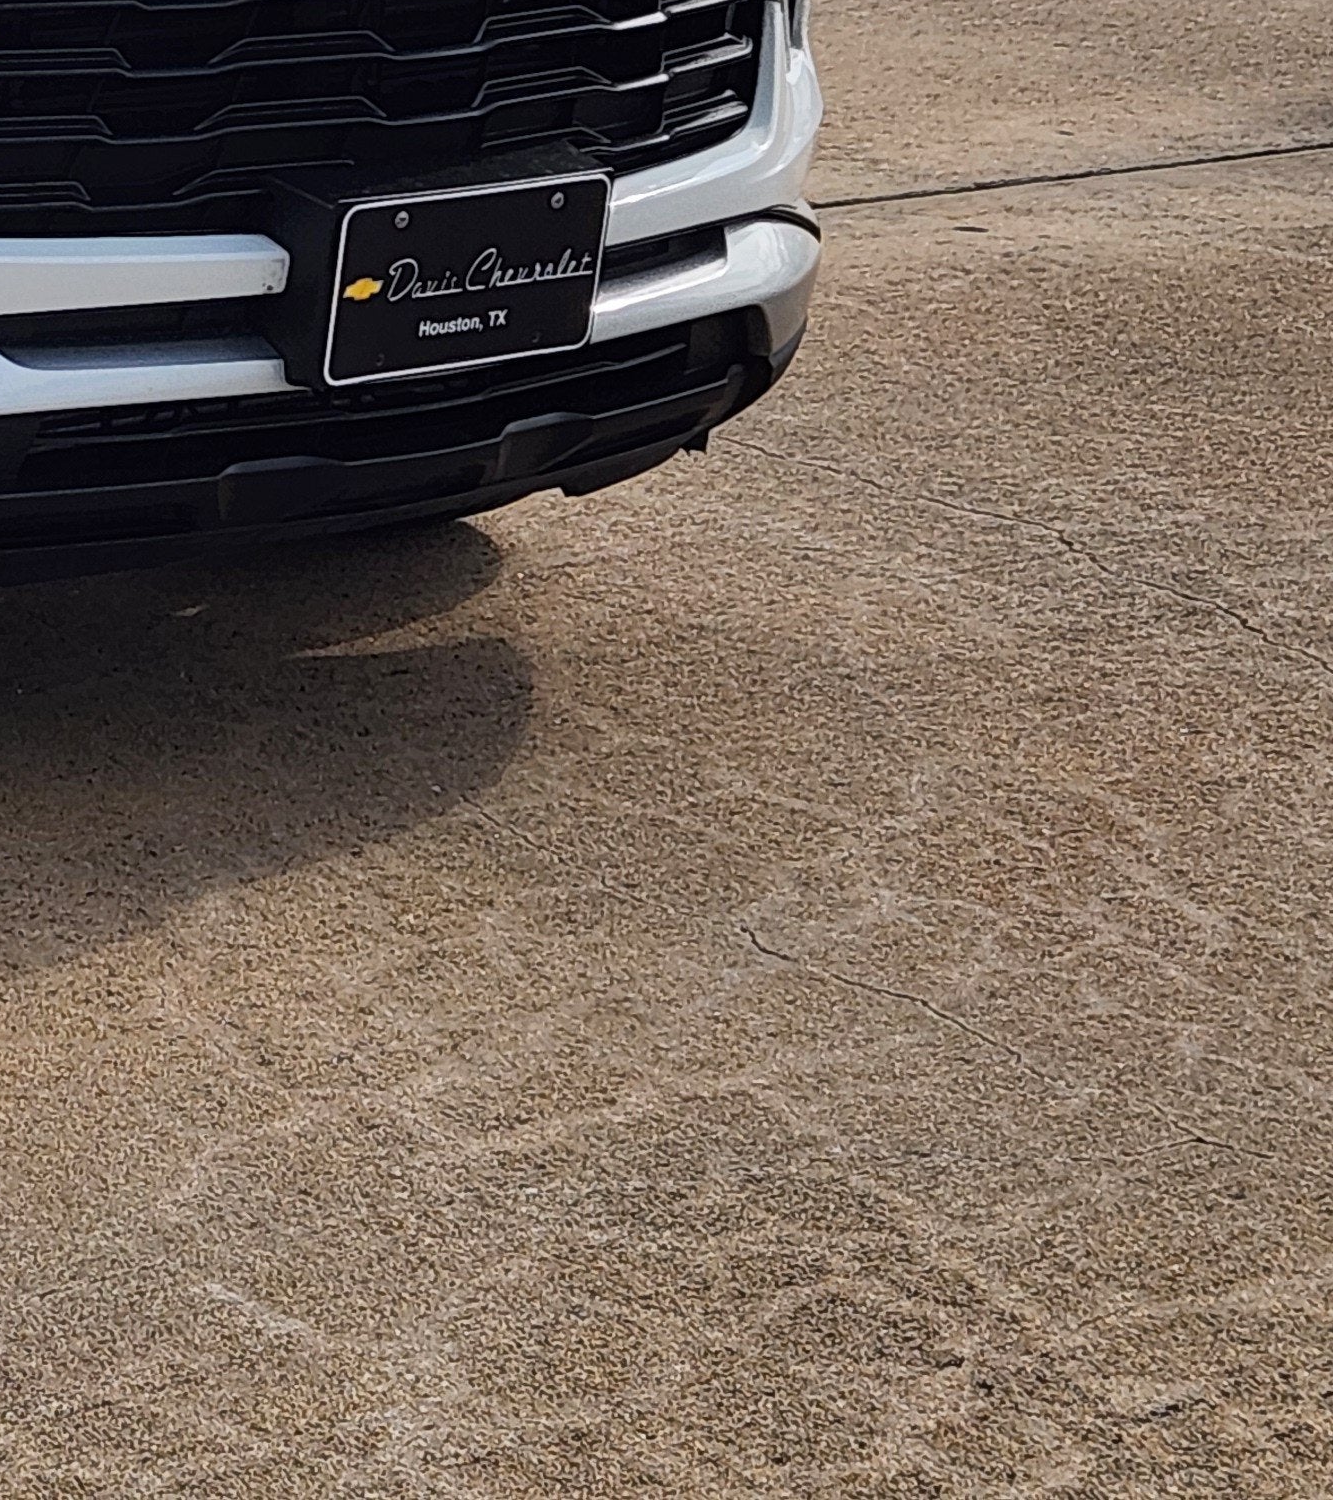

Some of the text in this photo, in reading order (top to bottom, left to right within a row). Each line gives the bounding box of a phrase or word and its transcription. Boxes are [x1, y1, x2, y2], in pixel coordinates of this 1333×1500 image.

[387, 248, 593, 302] Davis Chevrolet
[418, 309, 509, 338] Houston, TX
